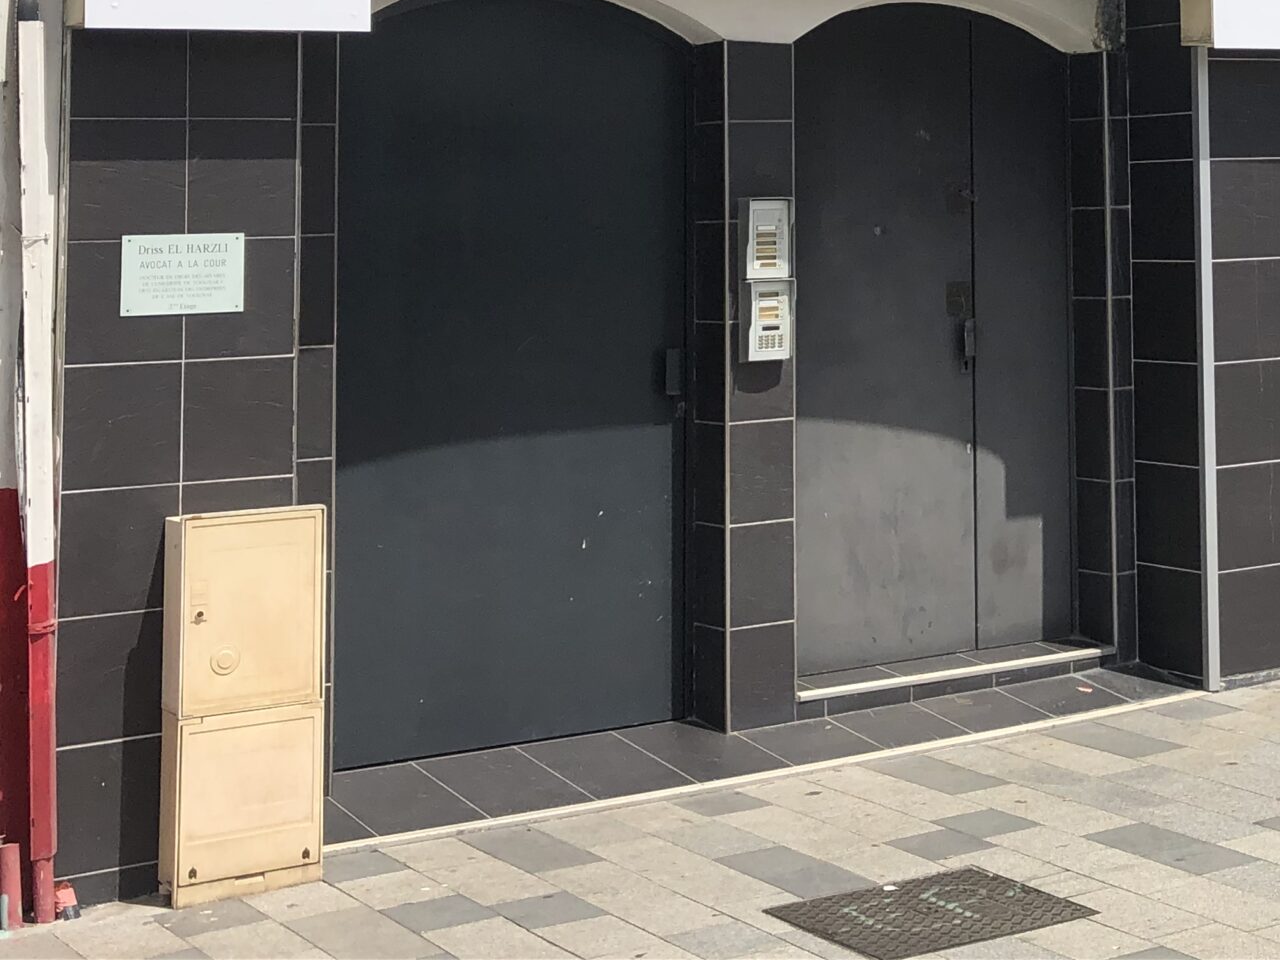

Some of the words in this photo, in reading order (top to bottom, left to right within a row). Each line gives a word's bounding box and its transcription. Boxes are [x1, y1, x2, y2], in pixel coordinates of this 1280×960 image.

[138, 244, 164, 256] Driss
[168, 244, 182, 254] EL
[186, 243, 228, 254] HARZLI
[140, 260, 172, 270] AVOCAT
[188, 259, 199, 268] LA
[203, 258, 228, 268] COUR
